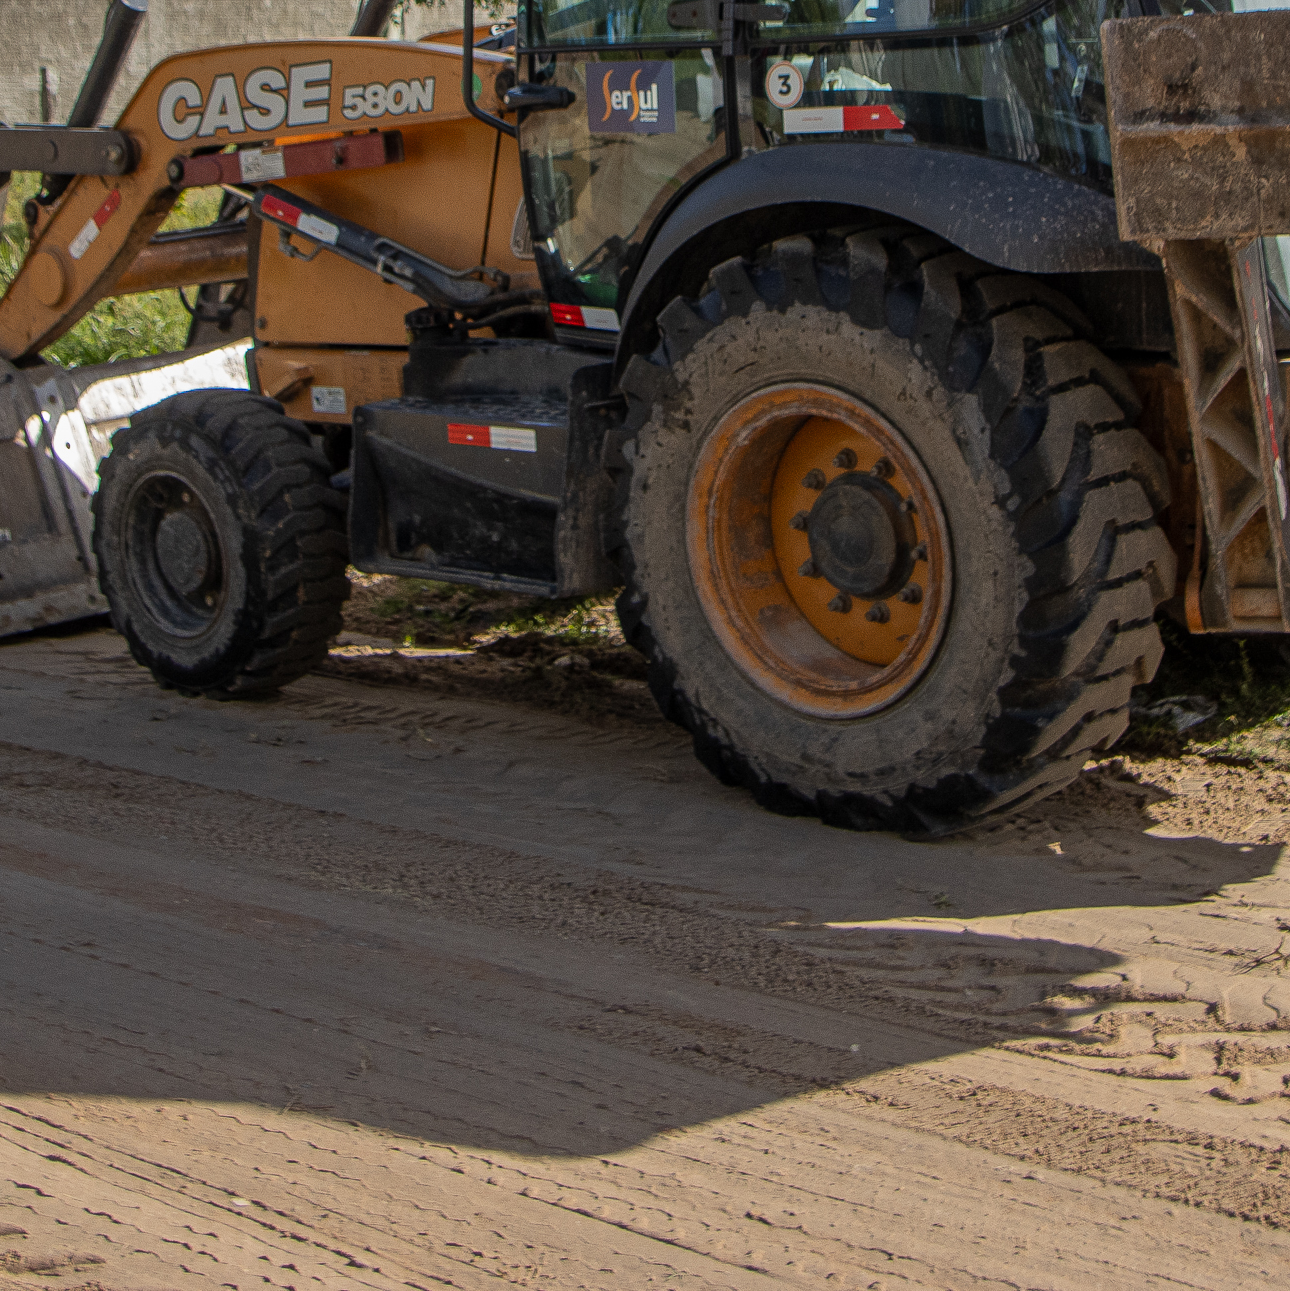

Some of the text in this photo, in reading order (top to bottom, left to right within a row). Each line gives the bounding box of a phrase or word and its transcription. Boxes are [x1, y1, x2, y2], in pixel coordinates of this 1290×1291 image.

[158, 60, 435, 140] CASE 580N
[602, 69, 658, 122] SerSul
[778, 73, 791, 97] 3
